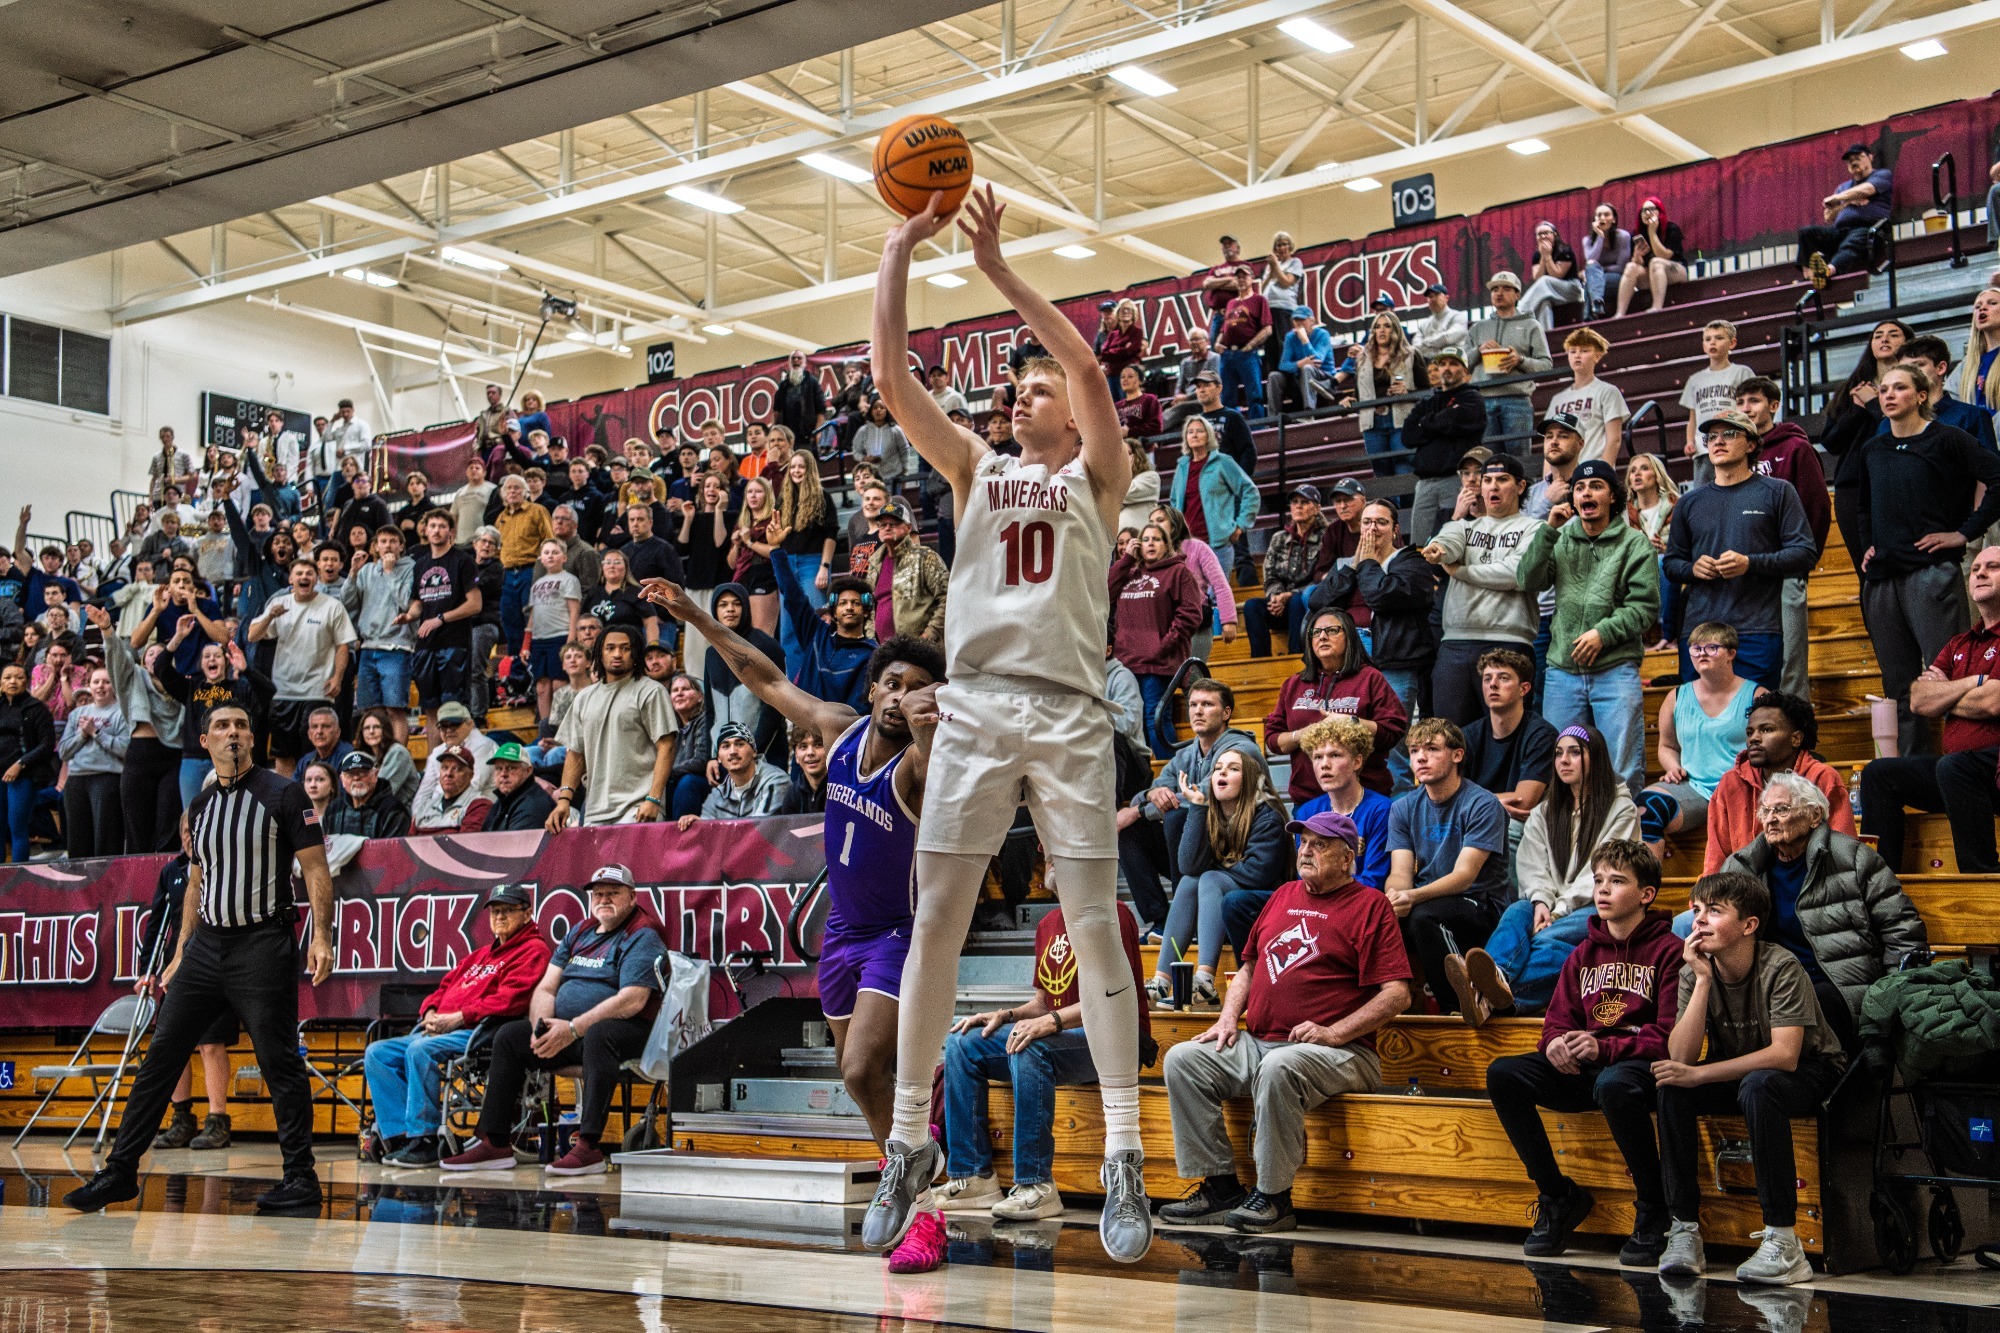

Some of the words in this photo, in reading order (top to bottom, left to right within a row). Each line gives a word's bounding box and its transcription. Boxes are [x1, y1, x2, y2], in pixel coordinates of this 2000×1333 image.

[904, 123, 965, 149] Wilson
[928, 156, 968, 177] NCAA
[1393, 185, 1436, 217] 103
[648, 350, 675, 375] 102
[649, 350, 925, 446] COLOA
[942, 324, 1035, 395] ME
[214, 414, 236, 427] HOME
[987, 480, 1069, 513] MAVERICKS
[1000, 520, 1055, 587] 10
[826, 782, 893, 832] HIGHLANDS
[839, 821, 855, 867] 1
[1022, 908, 1030, 923] E
[0, 911, 99, 984] THIS
[737, 1083, 748, 1100] B
[1345, 1151, 1351, 1159] 4
[1796, 1179, 1800, 1188] 1
